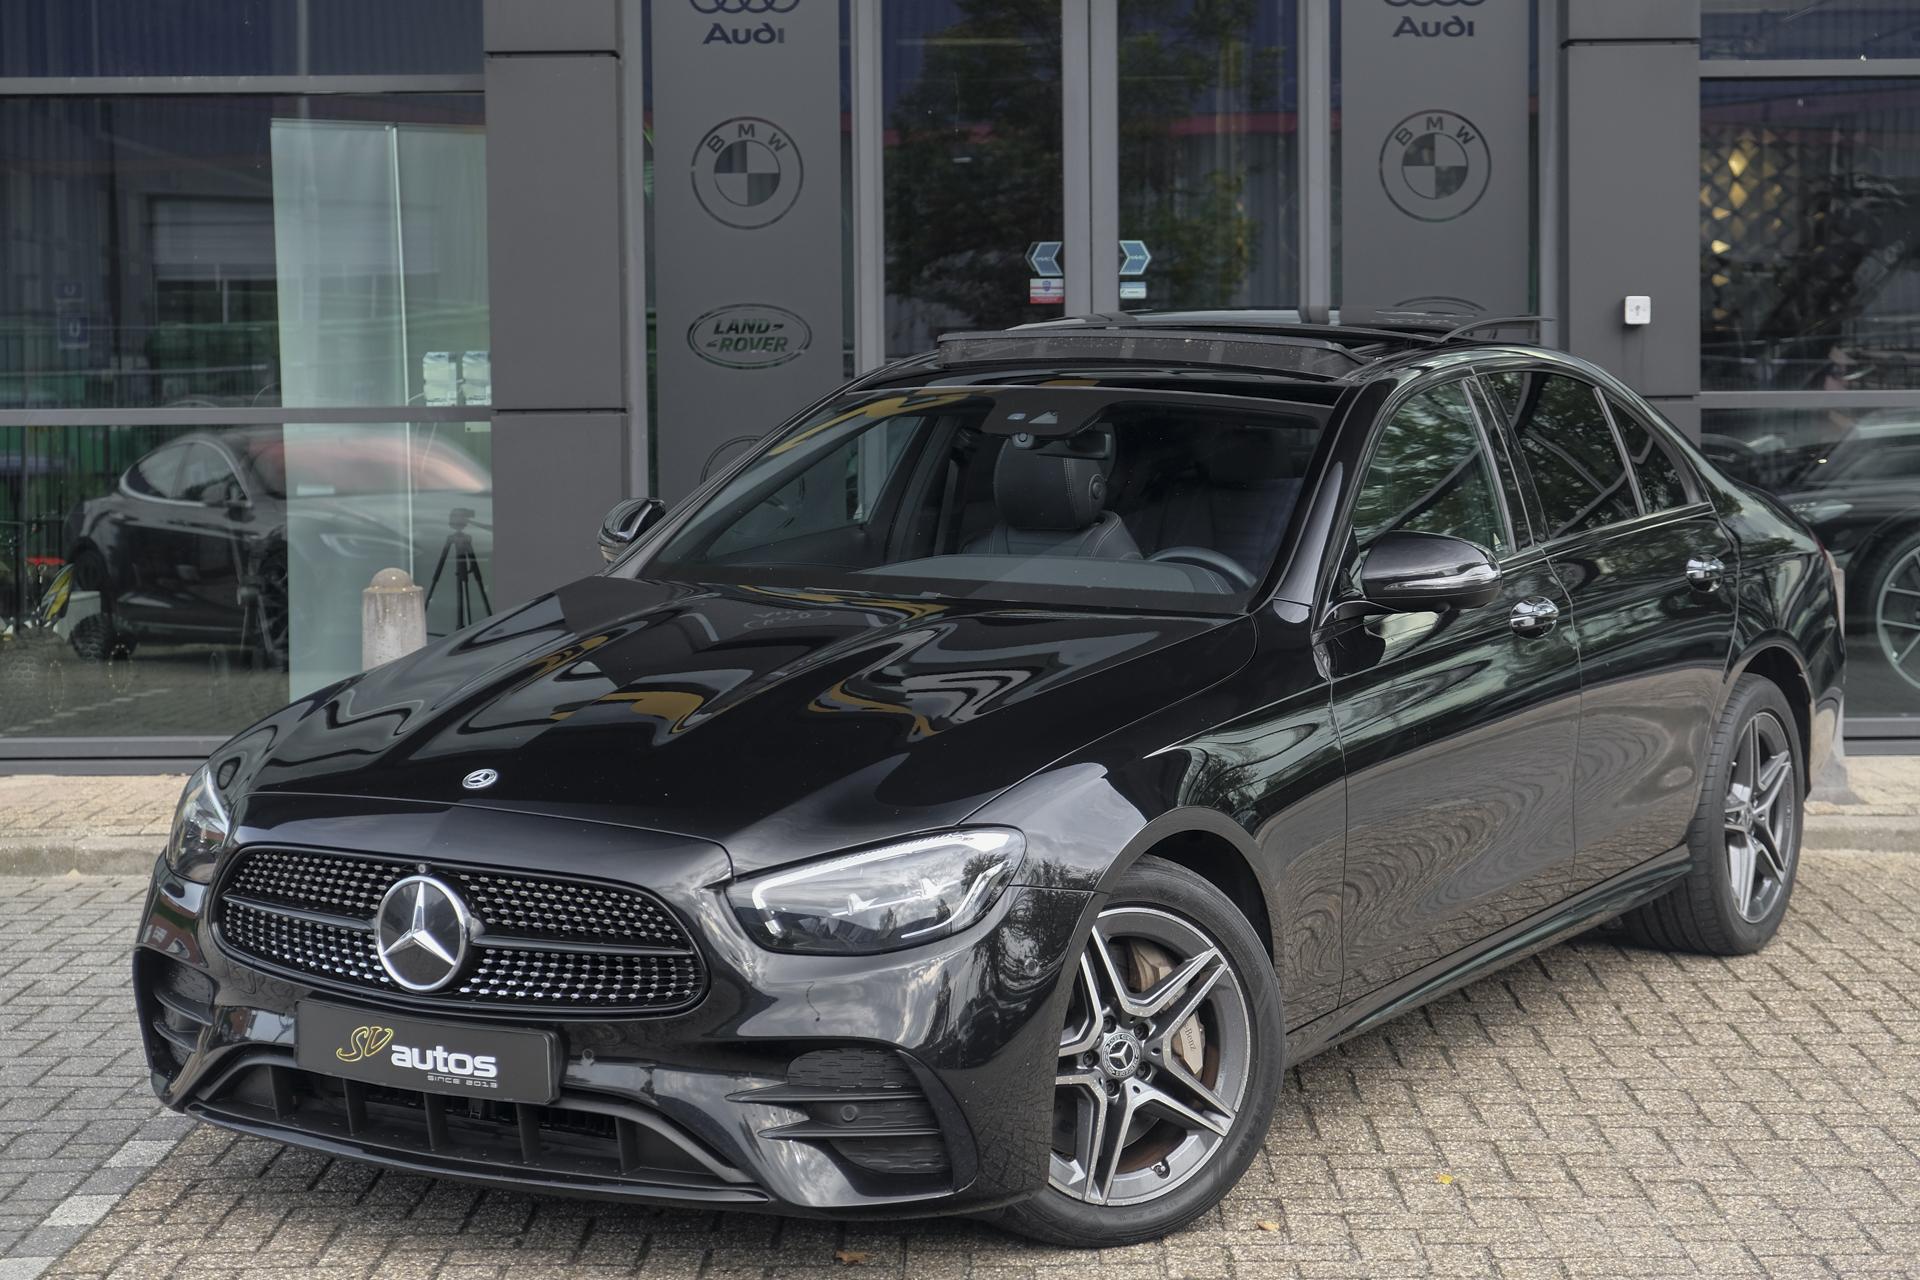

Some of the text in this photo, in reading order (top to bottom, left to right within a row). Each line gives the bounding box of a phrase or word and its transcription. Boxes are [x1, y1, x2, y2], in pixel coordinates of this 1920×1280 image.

[702, 22, 784, 45] Audi
[1392, 15, 1475, 38] Audi
[706, 123, 788, 154] BMW
[1394, 116, 1476, 147] BMW
[714, 319, 771, 335] LAND
[719, 336, 788, 352] ROVER
[336, 1026, 499, 1078] SV autos
[465, 1079, 498, 1089] 2013
